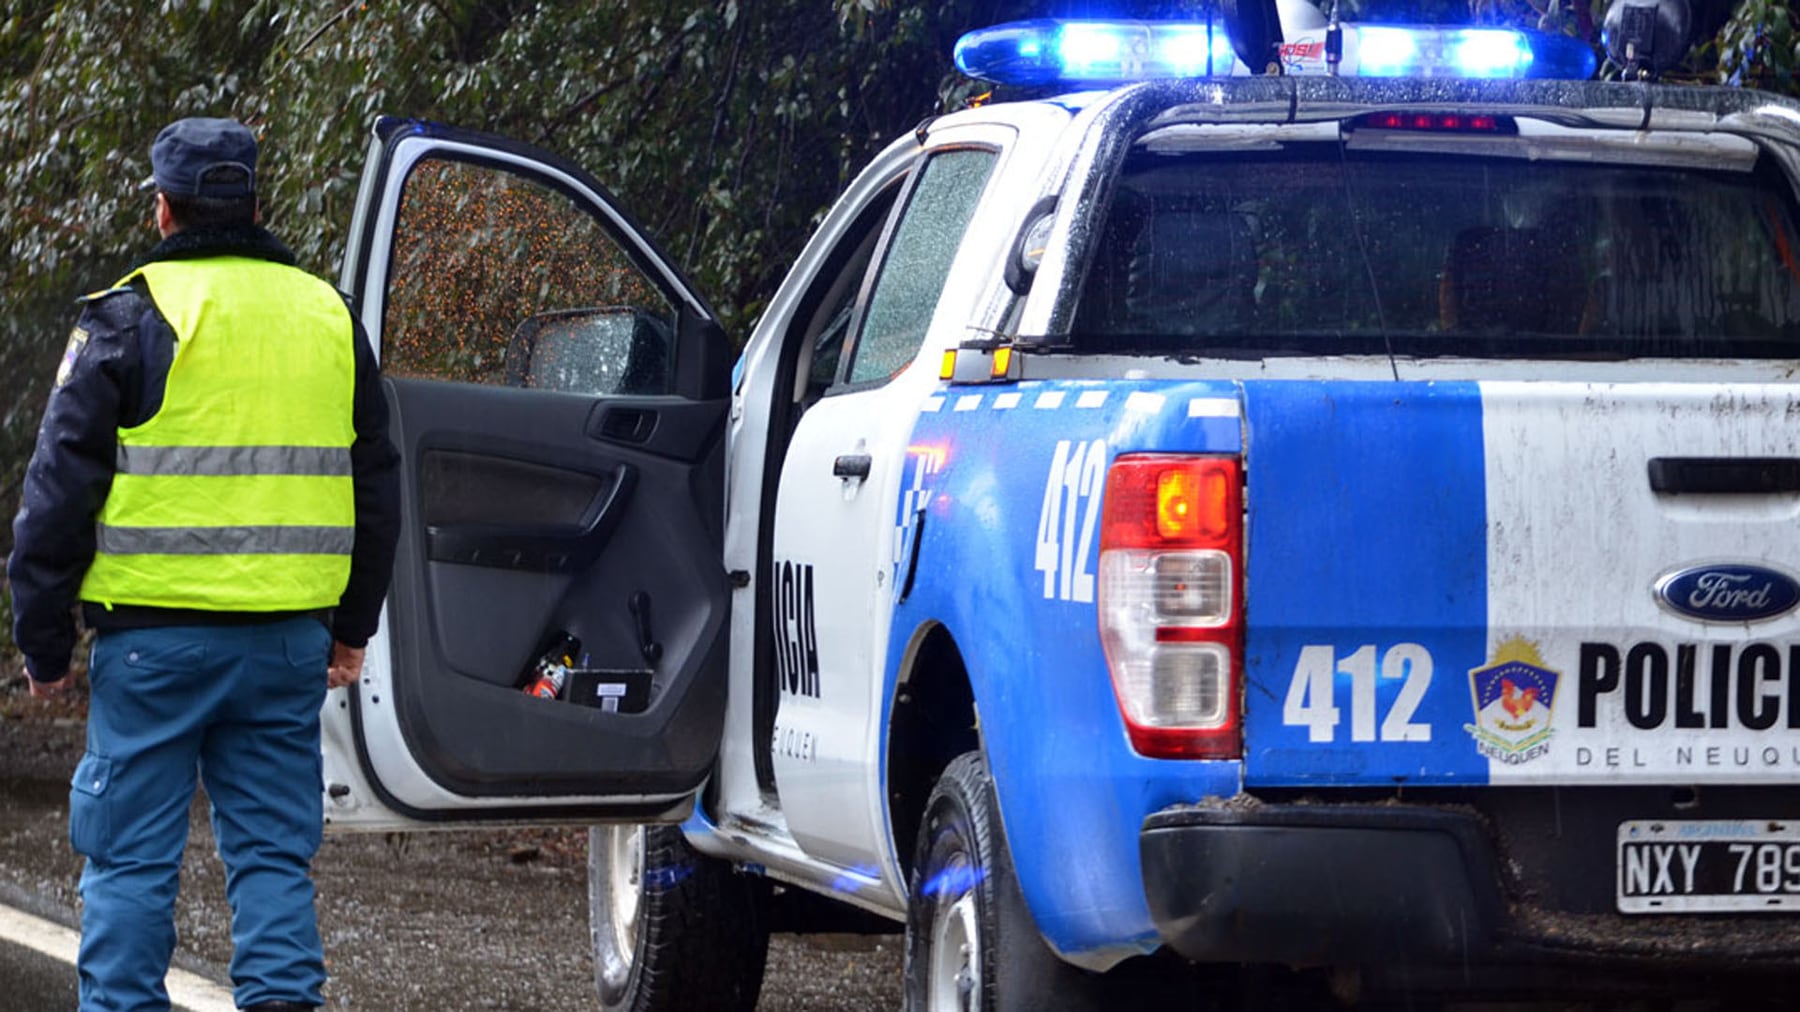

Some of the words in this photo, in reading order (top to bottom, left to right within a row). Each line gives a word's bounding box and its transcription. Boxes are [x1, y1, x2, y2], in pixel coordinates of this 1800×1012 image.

[1035, 439, 1106, 602] 412
[775, 560, 820, 698] ICIA
[1690, 572, 1772, 608] Ford
[1283, 642, 1434, 742] 412
[1578, 642, 1800, 730] POLICI
[1577, 747, 1647, 767] DEL
[1626, 844, 1701, 894] NXY
[1729, 844, 1800, 893] 789
